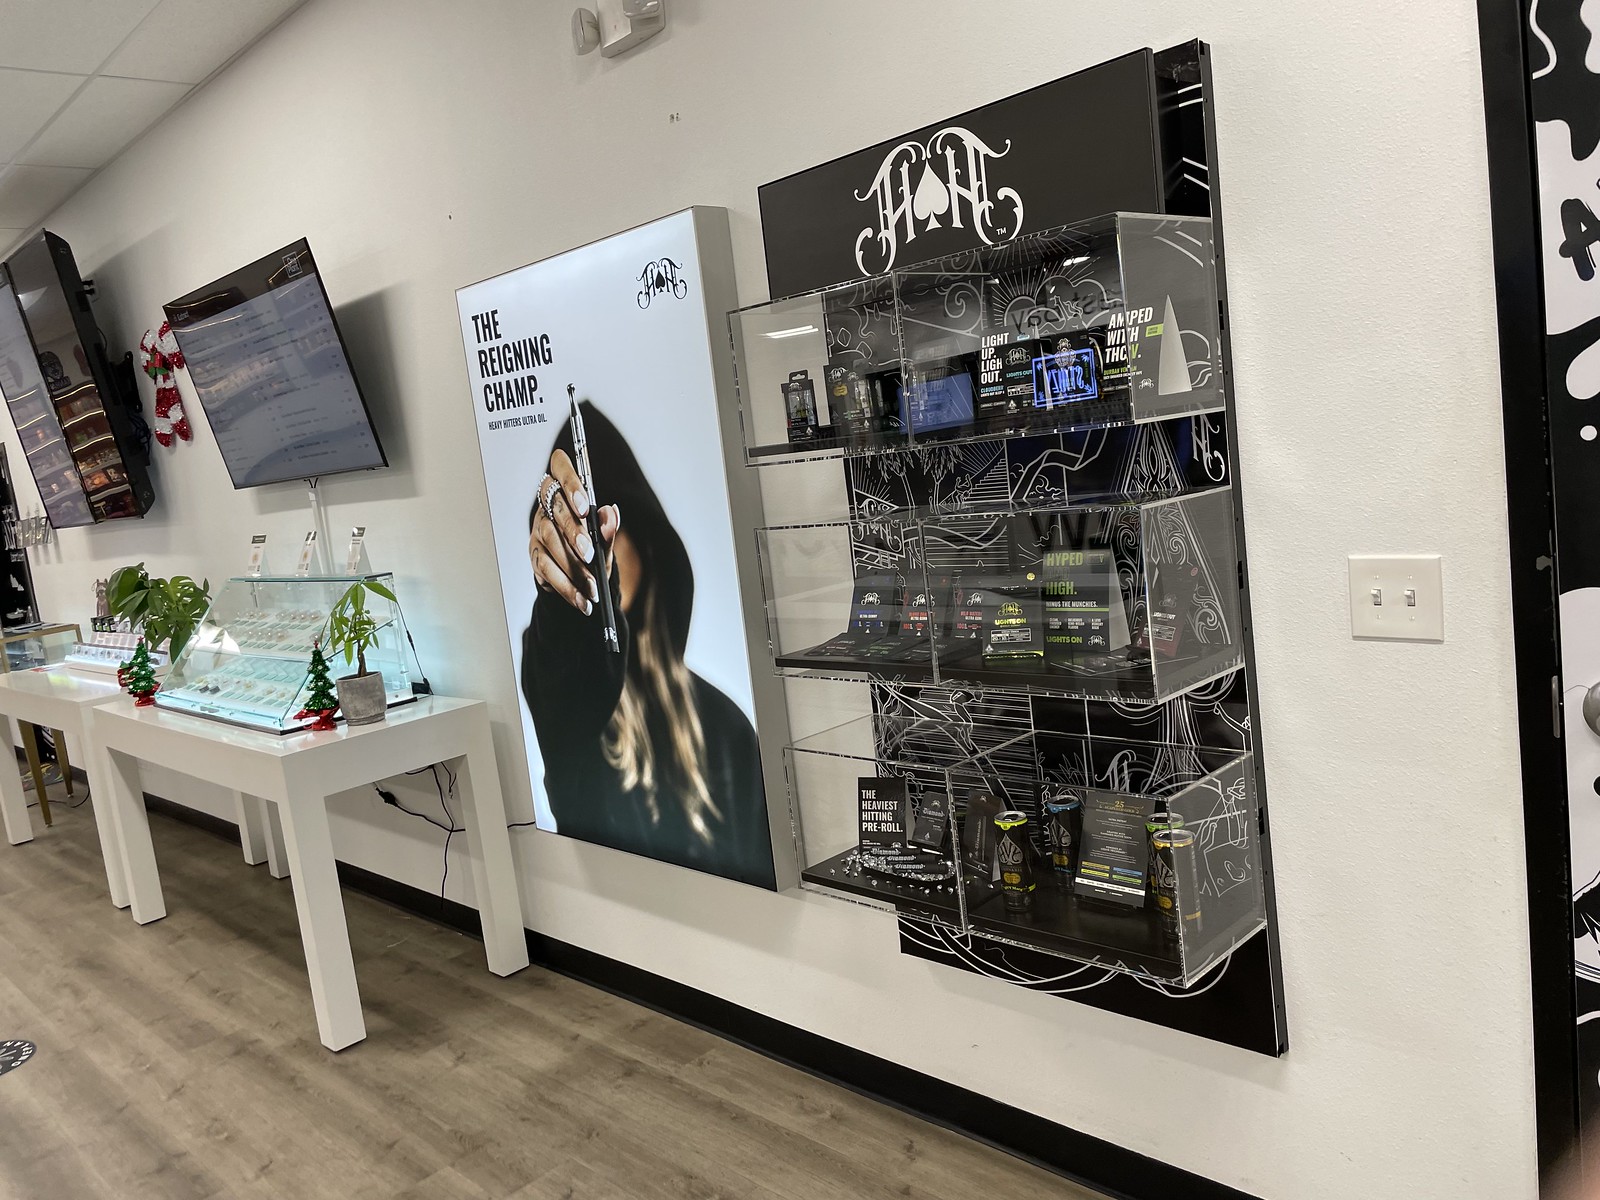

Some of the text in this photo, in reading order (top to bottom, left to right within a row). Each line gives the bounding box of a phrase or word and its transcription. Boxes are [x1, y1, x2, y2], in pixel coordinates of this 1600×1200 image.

[996, 227, 1007, 235] TM
[1108, 306, 1154, 329] AMPED
[471, 309, 502, 344] THE
[981, 332, 1010, 348] LIGHT
[1107, 326, 1140, 346] WITH
[477, 333, 553, 379] REIGNING
[981, 347, 997, 360] UP.
[980, 371, 1003, 384] OUT.
[1006, 370, 1023, 378] LIGHTS
[483, 374, 544, 412] CHAMP.
[488, 420, 503, 430] HEAVY
[503, 417, 522, 428] HITTERS
[522, 415, 537, 425] ULTRA
[1046, 552, 1084, 567] HYPED
[1045, 581, 1077, 595] HIGH.
[861, 790, 876, 799] THE
[861, 801, 898, 810] HEAVIEST
[1114, 800, 1125, 808] 25
[862, 811, 893, 821] HITTING
[862, 822, 904, 833] PRE-ROLL.
